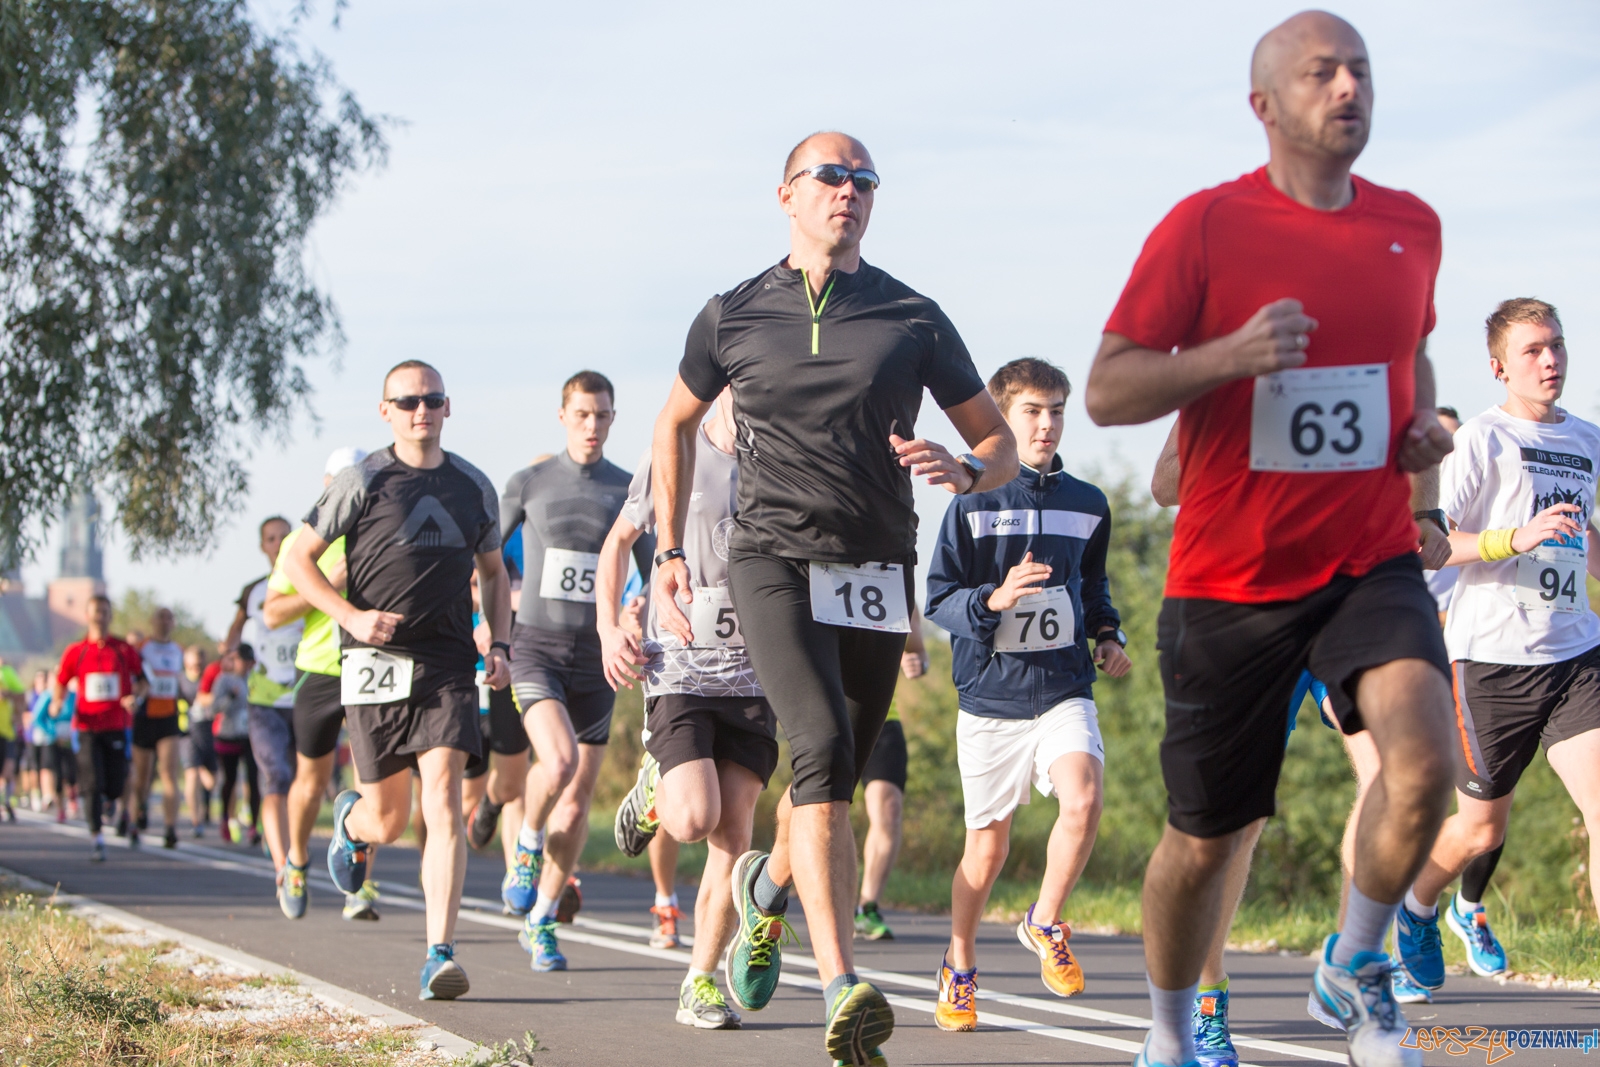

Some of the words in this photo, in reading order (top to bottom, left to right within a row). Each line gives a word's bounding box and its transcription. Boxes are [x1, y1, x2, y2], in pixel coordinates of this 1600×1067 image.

[1290, 399, 1363, 456] 63
[1549, 454, 1581, 467] BIEG
[1572, 472, 1586, 482] NA
[1001, 518, 1021, 526] asics
[560, 567, 596, 594] 85
[1539, 567, 1577, 603] 94
[835, 581, 887, 622] 18
[714, 607, 744, 639] 5
[1015, 608, 1060, 643] 76
[358, 665, 397, 695] 24
